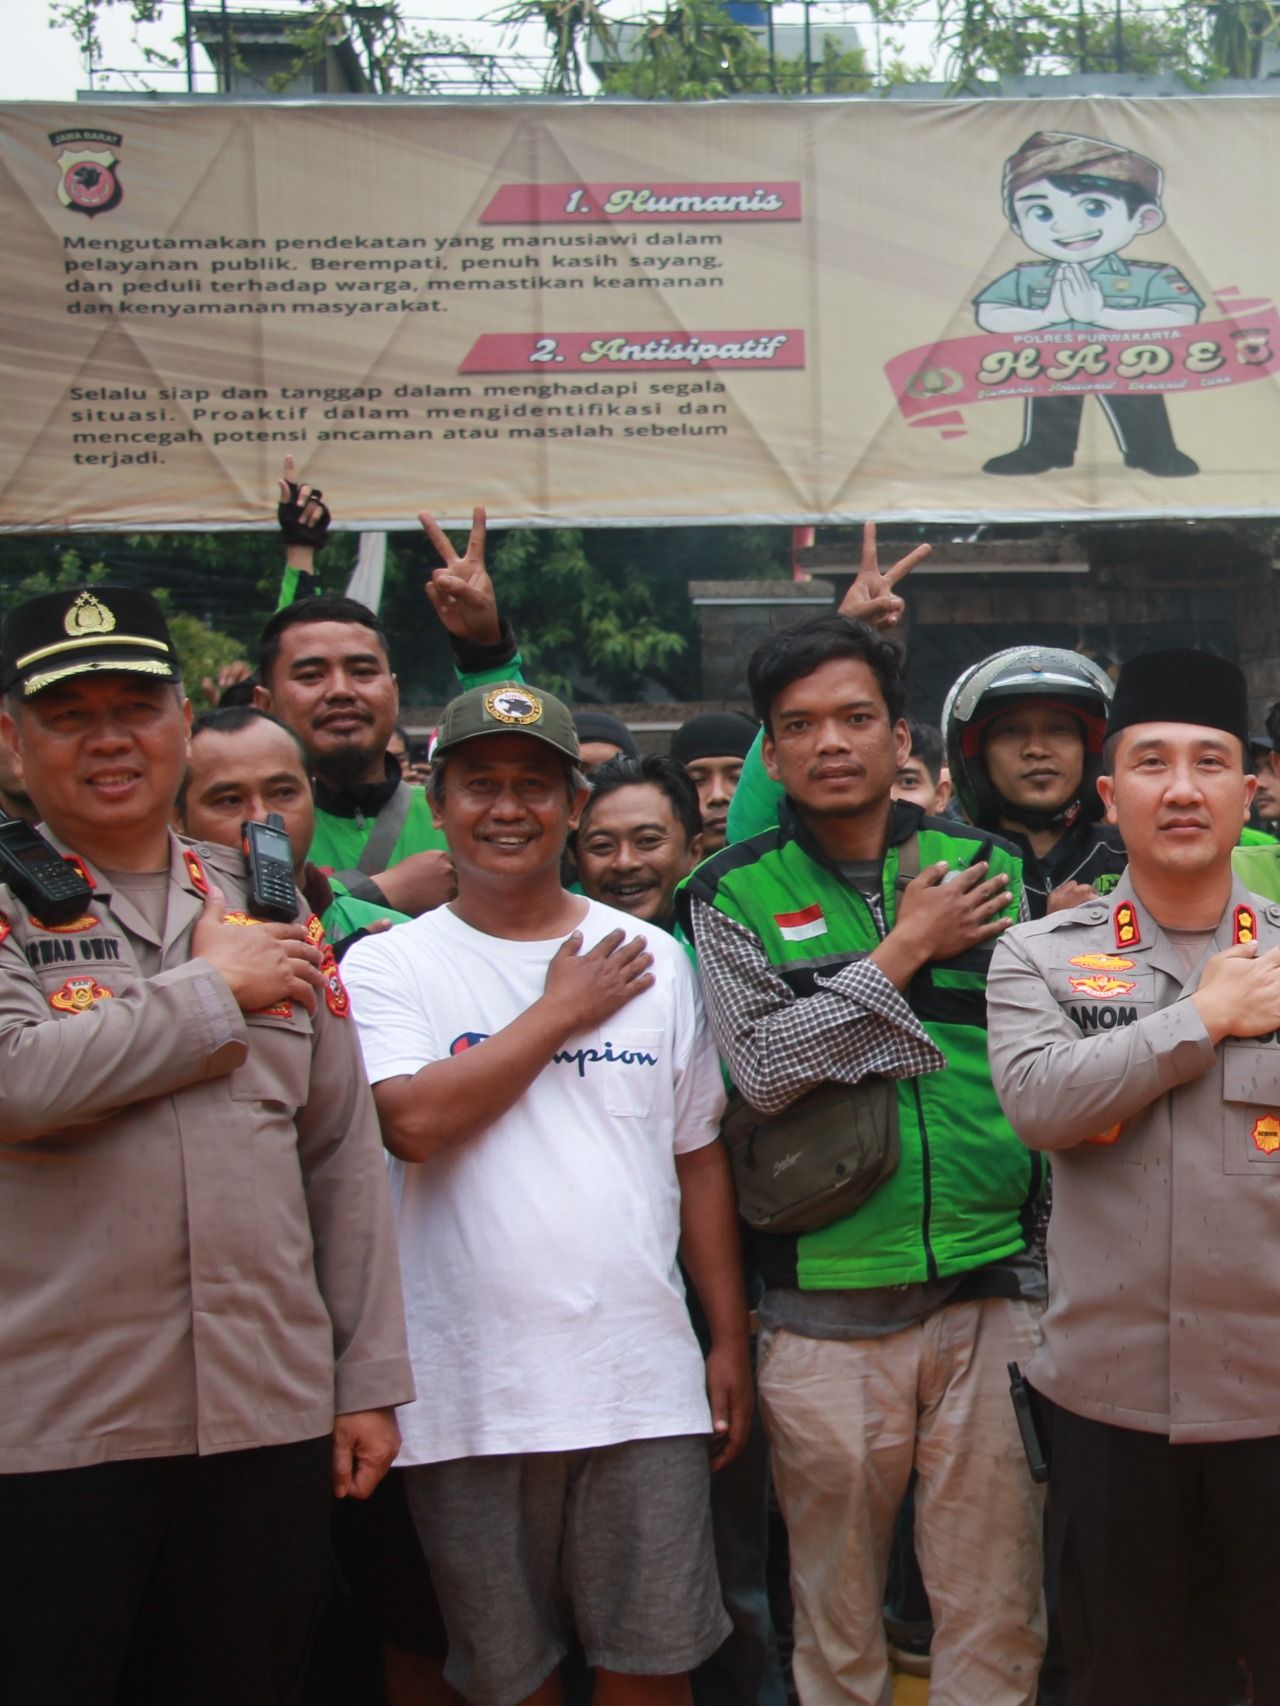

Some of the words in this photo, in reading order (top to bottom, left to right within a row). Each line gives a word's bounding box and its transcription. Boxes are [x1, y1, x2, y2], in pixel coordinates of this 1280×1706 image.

[565, 190, 590, 215] 1.
[604, 188, 782, 213] Humanis
[64, 235, 266, 254] Mengutamakan
[275, 235, 426, 253] pendekatan
[434, 234, 494, 252] yang
[502, 233, 637, 248] manusiawi
[645, 232, 722, 246] dalam
[64, 257, 199, 275] pelayanan
[211, 257, 297, 275] publik.
[461, 254, 540, 273] penuh
[552, 253, 617, 268] kasih
[66, 279, 113, 293] dan
[122, 279, 202, 296] peduli
[210, 278, 327, 296] terhadap
[426, 275, 584, 291] memastikan
[593, 275, 723, 289] keamanan
[66, 300, 113, 315] dan
[119, 300, 286, 318] kenyamanan
[291, 299, 447, 317] masyarakat.
[1013, 334, 1074, 345] POLRES
[1077, 330, 1181, 344] PURWAKARTA
[528, 338, 565, 364] 2.
[579, 336, 785, 366] Antisipatif
[69, 386, 147, 401] Selalu
[159, 386, 210, 403] siap
[221, 386, 268, 400] dan
[281, 386, 382, 402] tanggap
[394, 383, 471, 398] dalam
[484, 381, 637, 399] menghadapi
[649, 380, 726, 398] segala
[71, 407, 174, 423] situasi.
[193, 406, 308, 422] Proaktif
[324, 406, 409, 420] dalam
[427, 402, 661, 422] mengidentifikasi
[678, 401, 727, 416] dan
[73, 428, 203, 447] mencegah
[213, 427, 306, 446] potensi
[317, 429, 433, 442] ancaman
[443, 427, 499, 440] atau
[508, 424, 613, 439] masalah
[624, 423, 727, 438] sebelum
[73, 450, 165, 469] terjadi.
